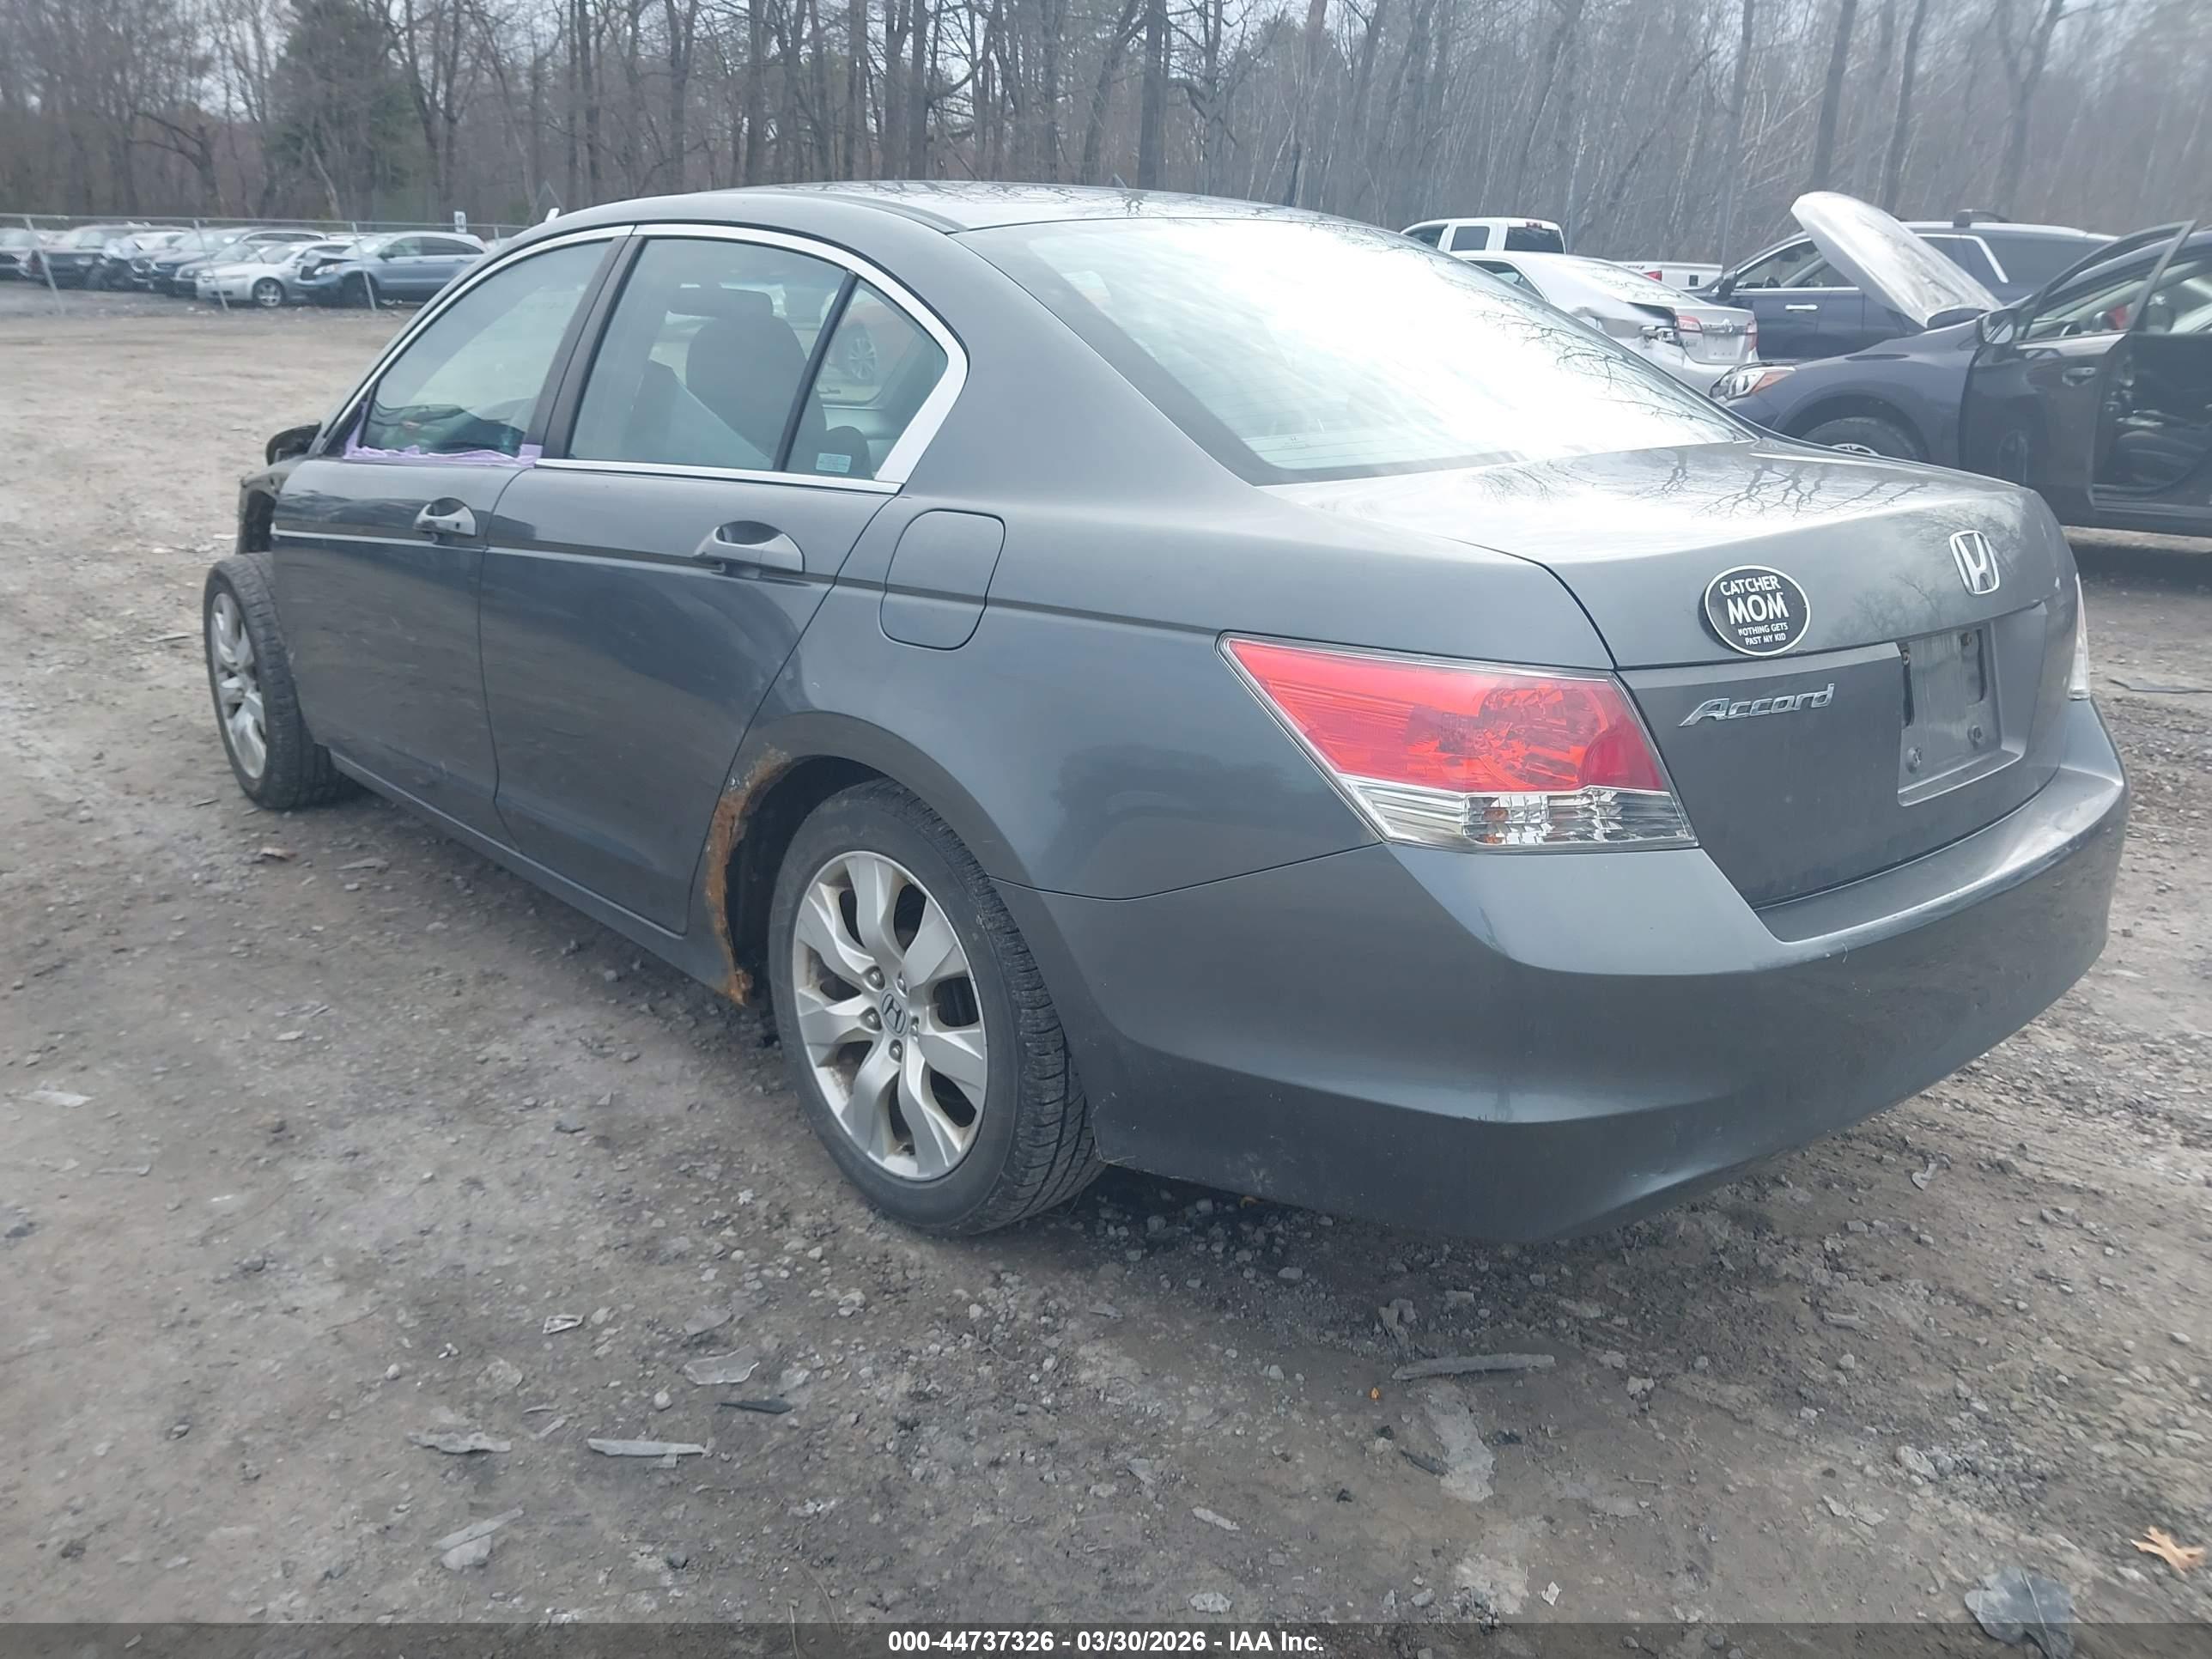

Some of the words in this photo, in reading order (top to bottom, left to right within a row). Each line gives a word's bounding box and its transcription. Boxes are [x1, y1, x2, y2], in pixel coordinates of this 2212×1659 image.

[1720, 575, 1781, 595] CATCHER
[1727, 592, 1790, 624] MOM
[1738, 625, 1770, 636] NOTHING
[1771, 623, 1789, 631] GETS
[1745, 636, 1762, 646] PAST
[1763, 635, 1773, 643] MY
[1774, 633, 1786, 641] KID
[1678, 683, 1835, 727] Accord
